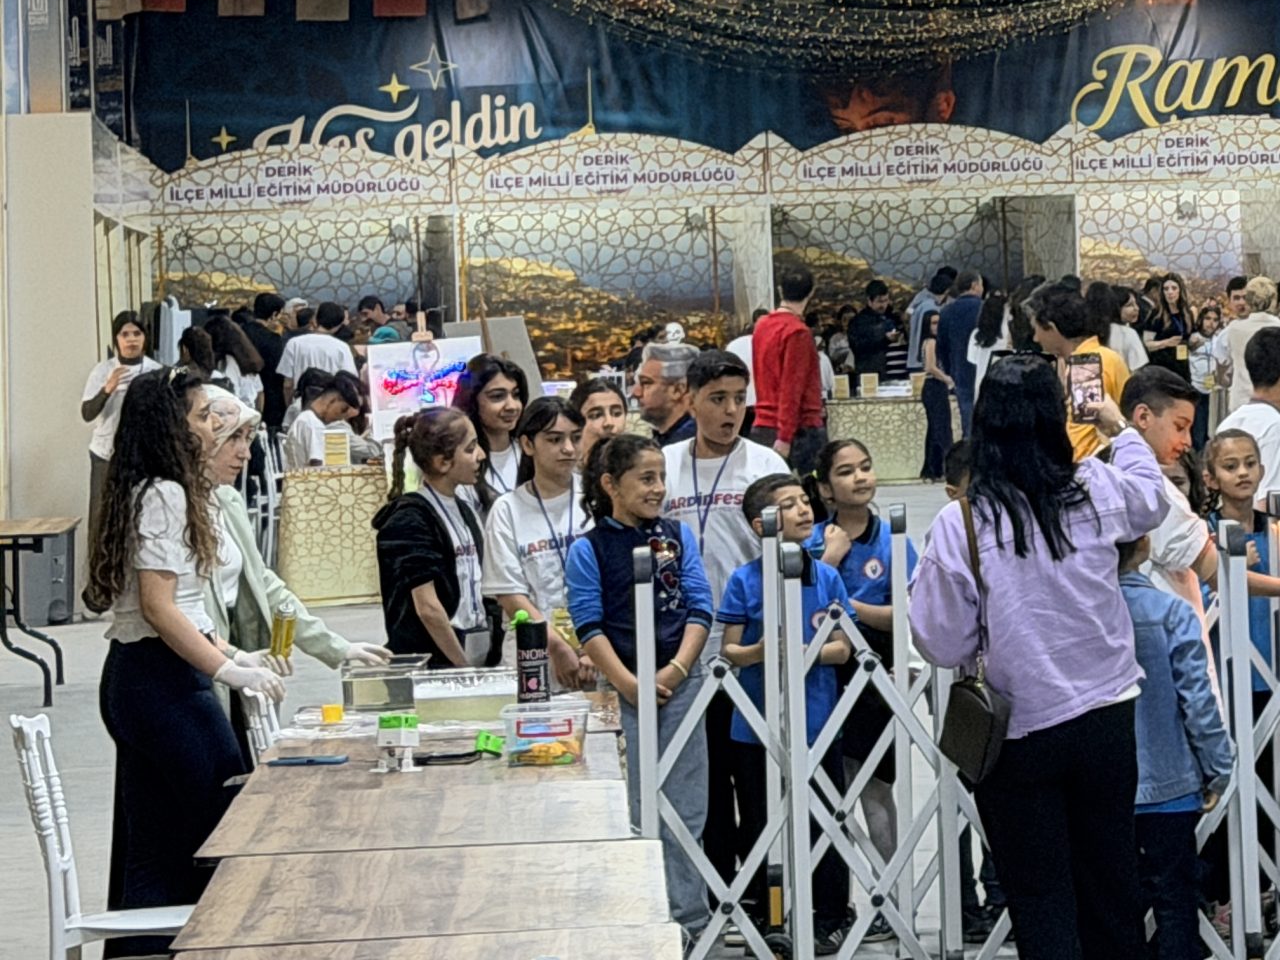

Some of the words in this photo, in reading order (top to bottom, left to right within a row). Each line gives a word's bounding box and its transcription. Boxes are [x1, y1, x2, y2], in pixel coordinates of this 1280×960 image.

[394, 94, 543, 162] geldin
[893, 142, 940, 156] DERİK
[1164, 136, 1210, 149] DERİK
[583, 151, 629, 166] DERİK
[1075, 155, 1107, 172] İLÇE
[1112, 154, 1151, 169] MİLLİ
[1156, 152, 1209, 168] EĞİTİM
[264, 162, 313, 177] DERİK
[490, 174, 524, 190] İLÇE
[528, 172, 570, 188] MİLLİ
[575, 169, 628, 185] EĞİTİM
[633, 166, 735, 183] MÜDÜRLÜĞÜ
[803, 165, 836, 181] İLÇE
[841, 162, 881, 177] MİLLİ
[886, 160, 939, 176] EĞİTİM
[943, 157, 1043, 174] MÜDÜRLÜĞÜ
[170, 186, 205, 202] İLÇE
[210, 183, 251, 199] MİLLİ
[257, 181, 311, 197] EĞİTİM
[316, 178, 420, 195] MÜDÜRLÜĞÜ
